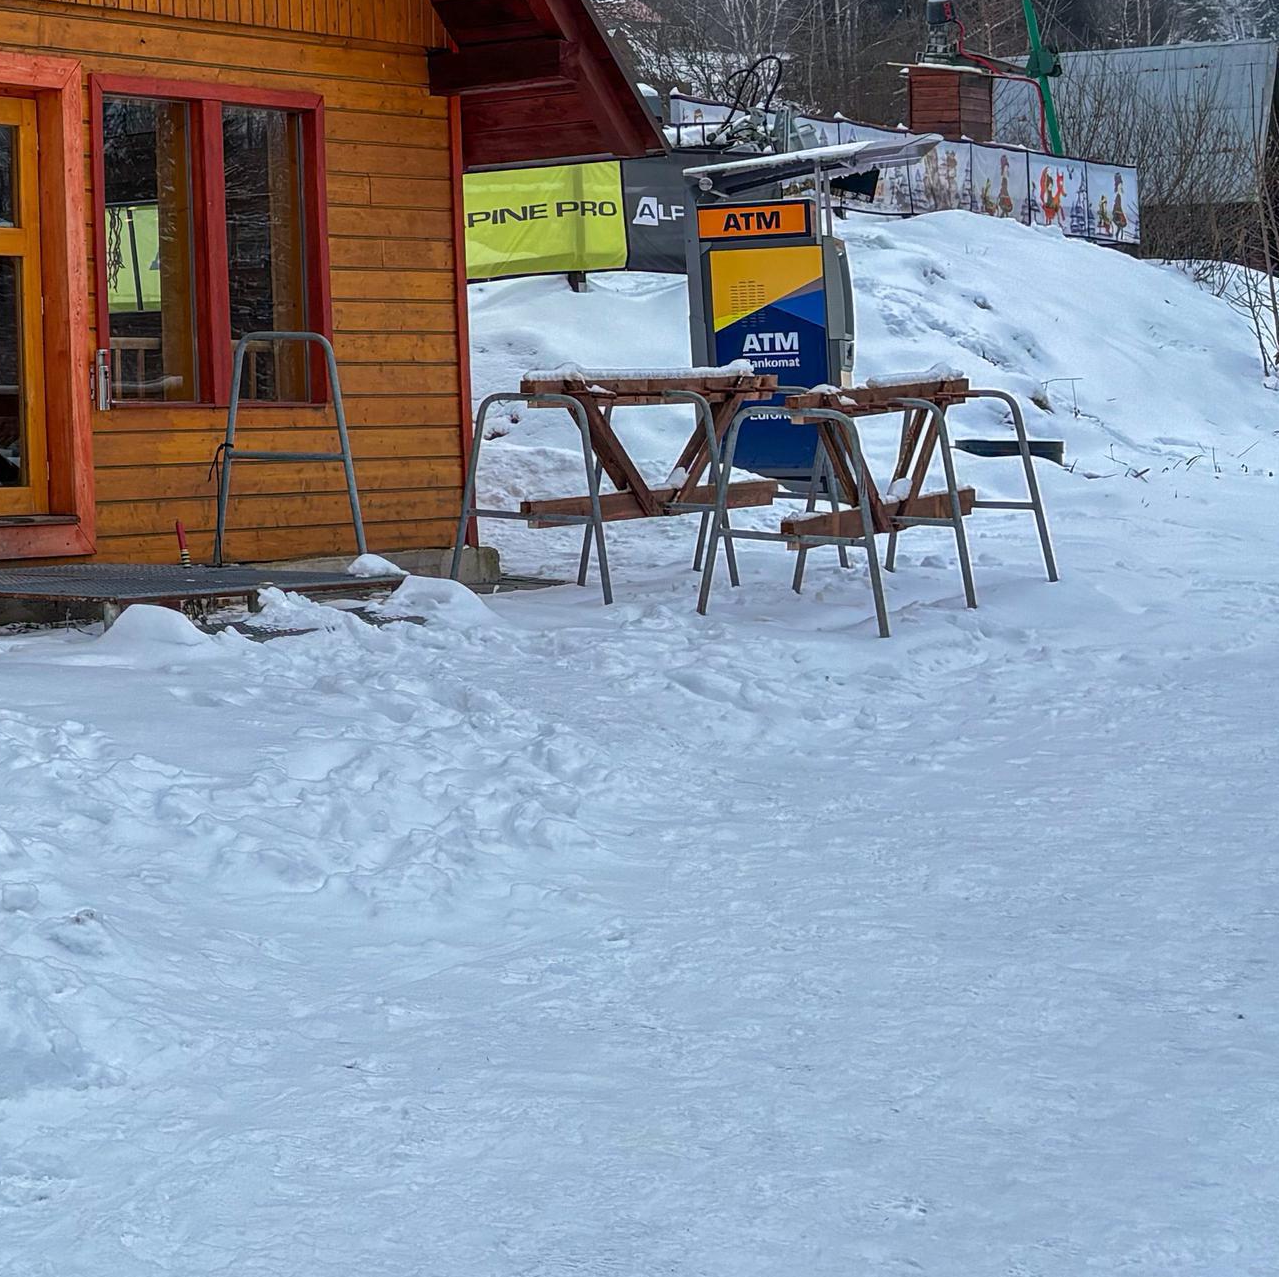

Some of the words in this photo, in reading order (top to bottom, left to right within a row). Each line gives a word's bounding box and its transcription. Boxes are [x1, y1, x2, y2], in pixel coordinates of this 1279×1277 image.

[465, 204, 548, 228] PINE
[556, 201, 617, 217] PRO
[723, 211, 780, 231] ATM
[742, 332, 799, 352] ATM
